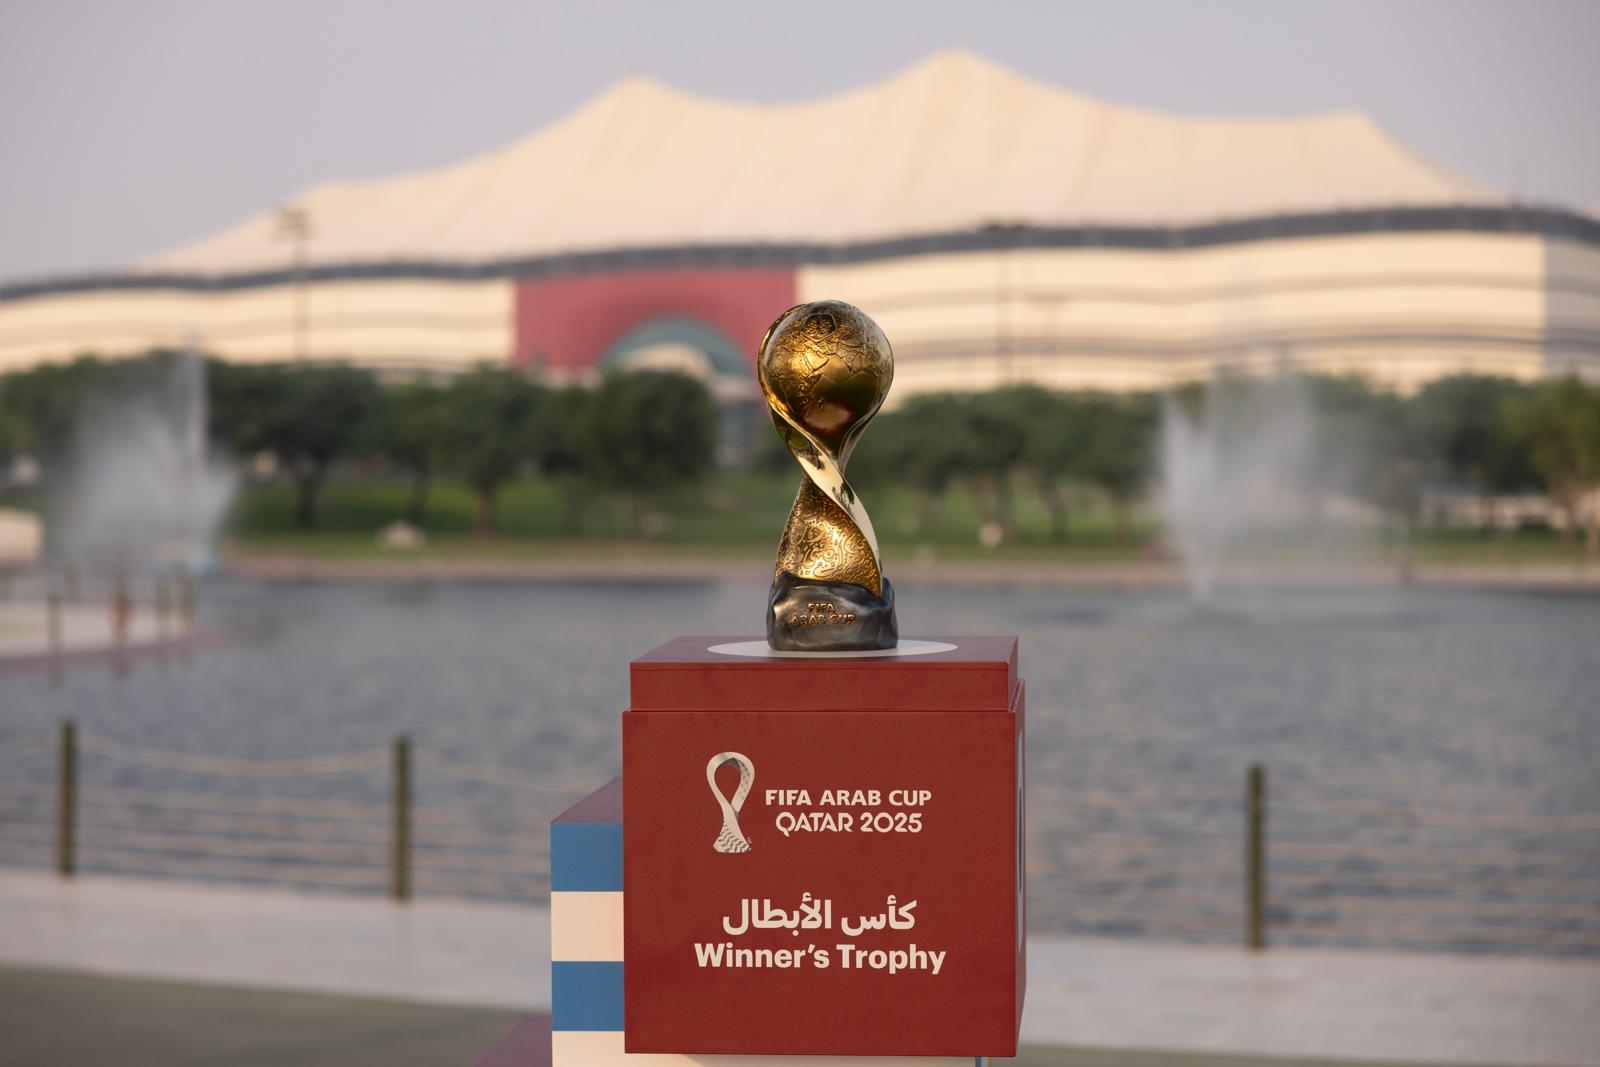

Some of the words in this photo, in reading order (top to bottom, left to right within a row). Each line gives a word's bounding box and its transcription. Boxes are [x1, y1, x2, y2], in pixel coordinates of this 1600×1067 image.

[790, 614, 825, 625] ARAB
[830, 614, 856, 625] CUP
[808, 603, 835, 613] FIFA
[765, 789, 813, 806] FIFA
[818, 789, 882, 806] ARAB
[888, 789, 932, 807] CUP
[775, 811, 854, 838] QATAR
[859, 811, 923, 834] 2025
[722, 891, 832, 937] الأبطال
[840, 894, 918, 937] كأس
[693, 942, 830, 969] Winner’s
[835, 943, 947, 975] Trophy
